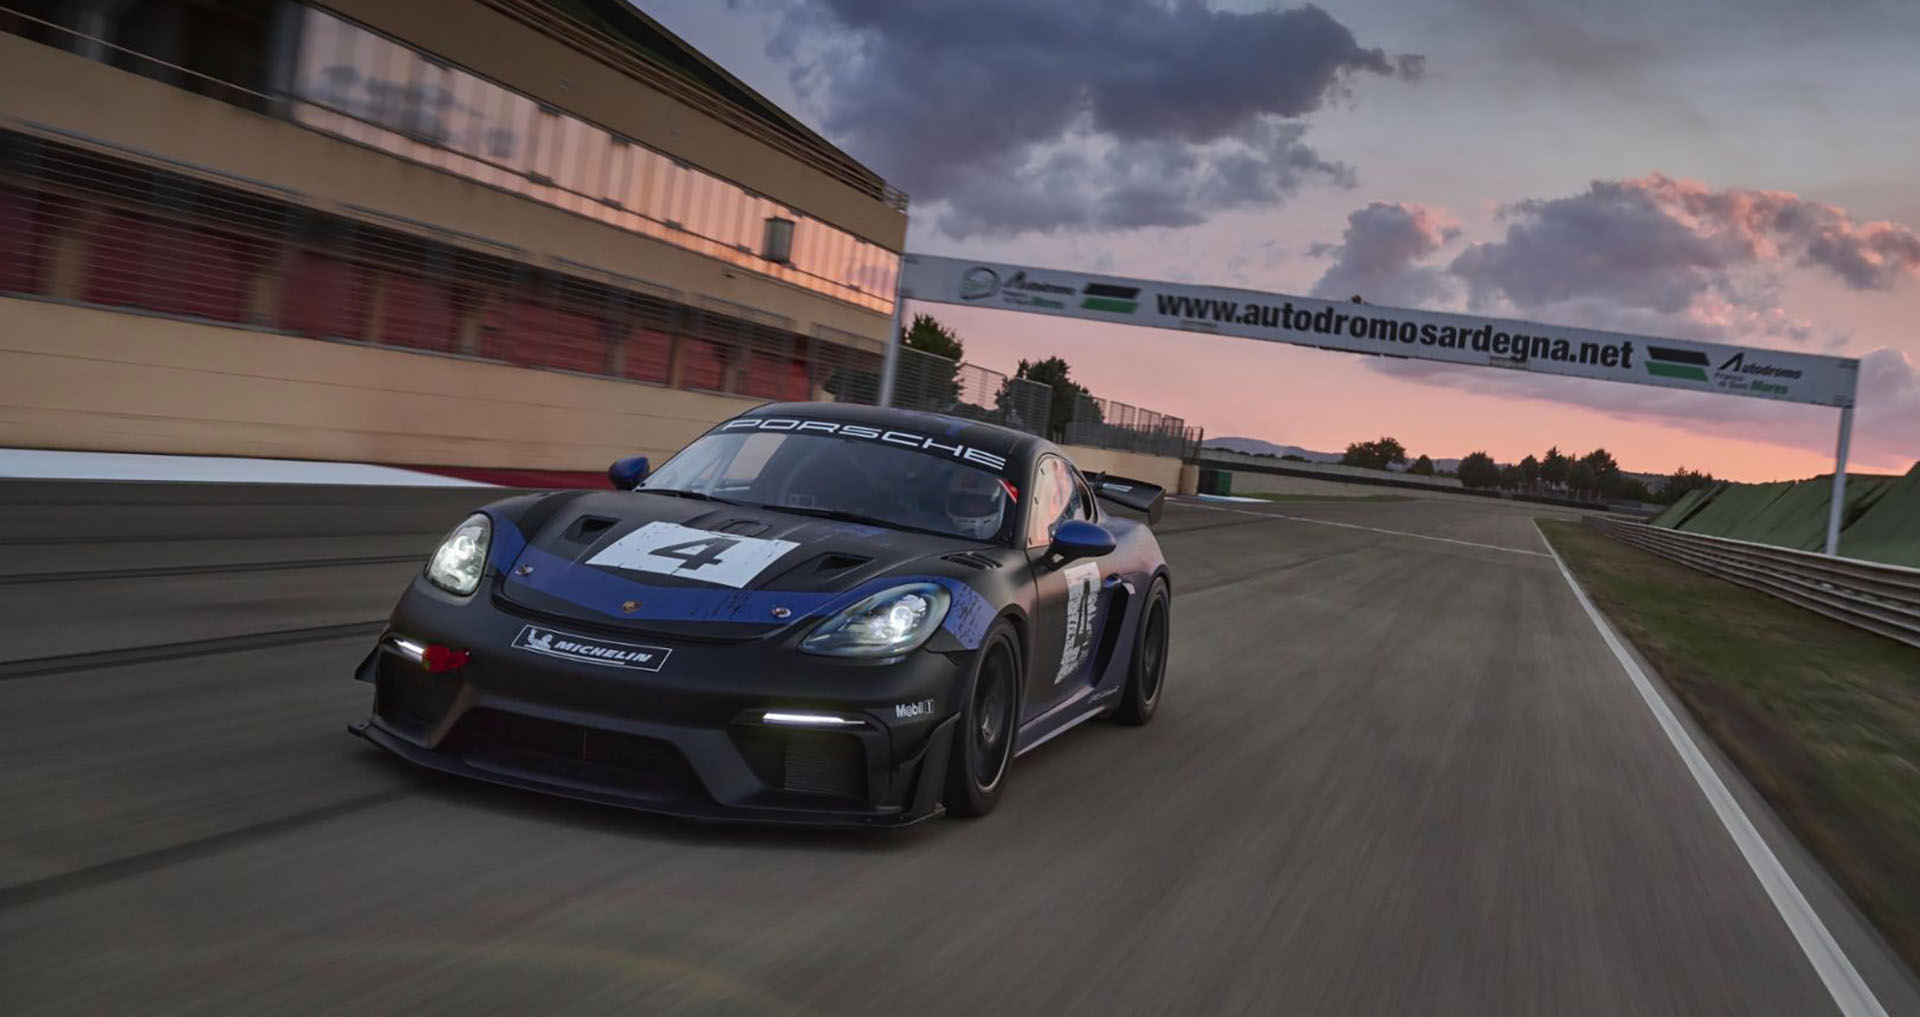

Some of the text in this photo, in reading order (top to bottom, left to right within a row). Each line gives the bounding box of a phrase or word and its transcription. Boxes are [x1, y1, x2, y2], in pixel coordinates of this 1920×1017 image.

[1157, 293, 1634, 369] www.autodromosardegna.net
[1718, 352, 1802, 380] Autodromo
[723, 418, 1006, 471] PORSCHE
[648, 537, 741, 571] 4
[554, 640, 653, 663] MICHELIN
